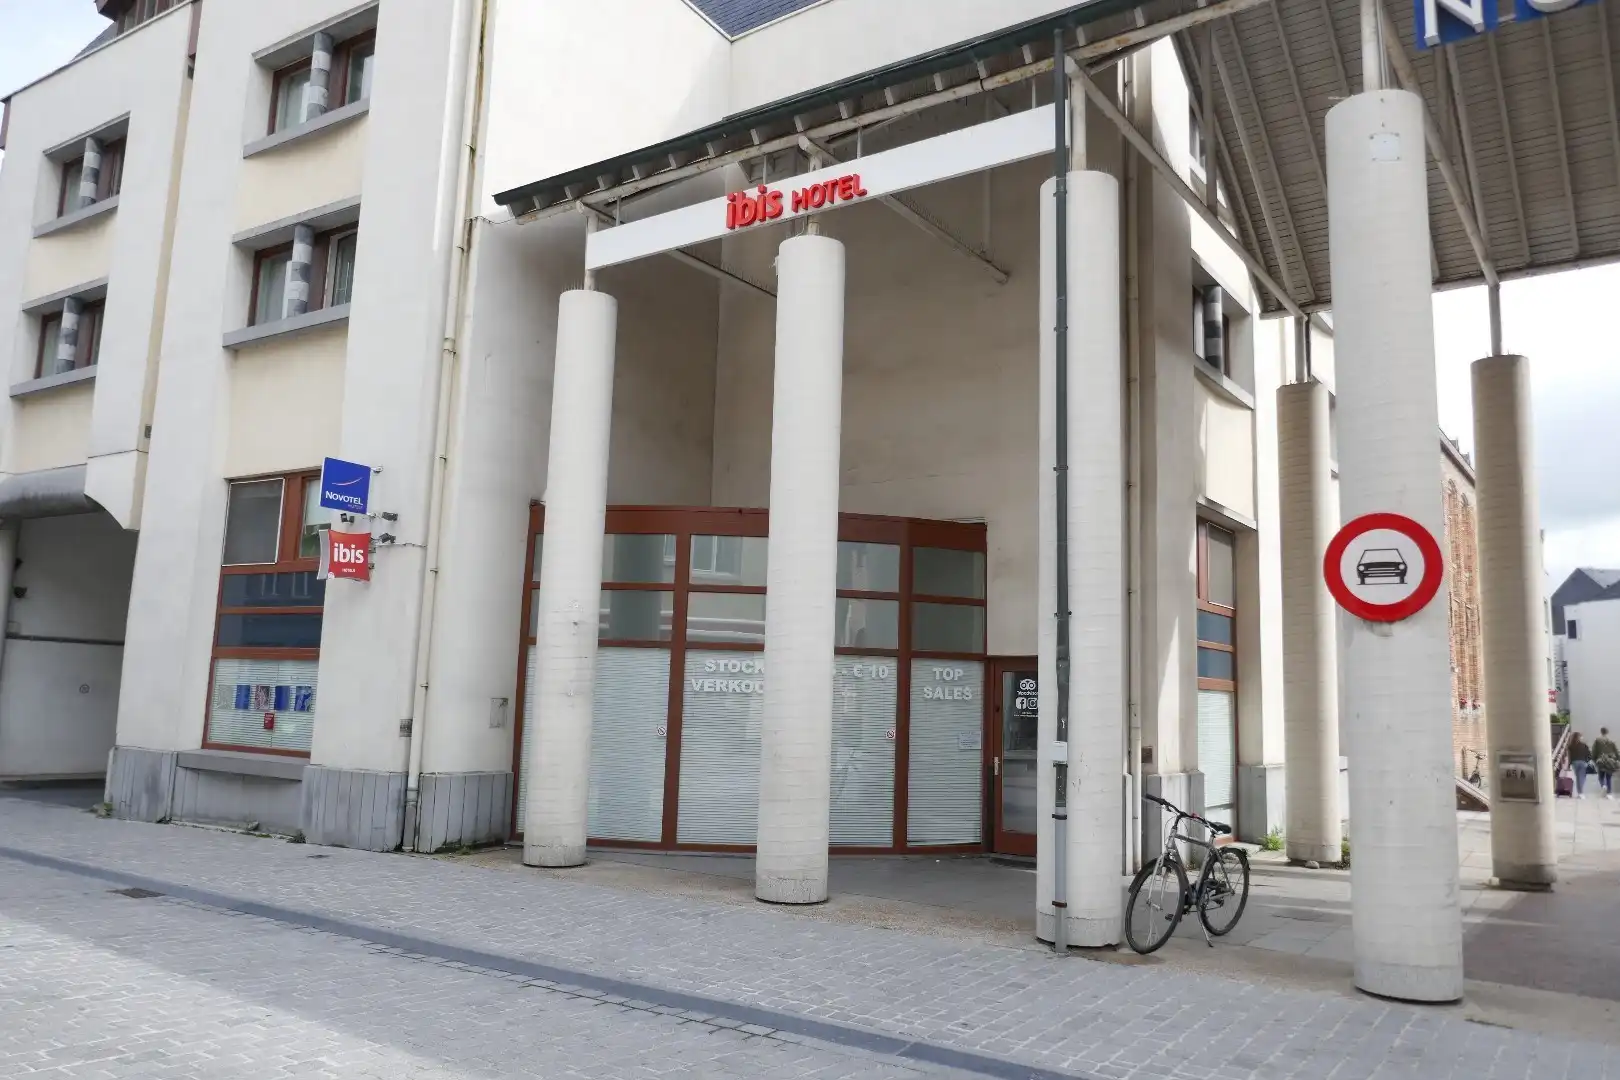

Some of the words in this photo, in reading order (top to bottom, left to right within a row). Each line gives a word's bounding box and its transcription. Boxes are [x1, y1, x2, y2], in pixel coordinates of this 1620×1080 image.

[726, 184, 783, 229] ibis
[792, 174, 867, 213] HOTEL
[325, 490, 363, 506] NOVOTEL
[333, 542, 364, 564] ibis
[869, 664, 889, 679] 10
[932, 667, 963, 681] TOP
[923, 686, 973, 701] SALES
